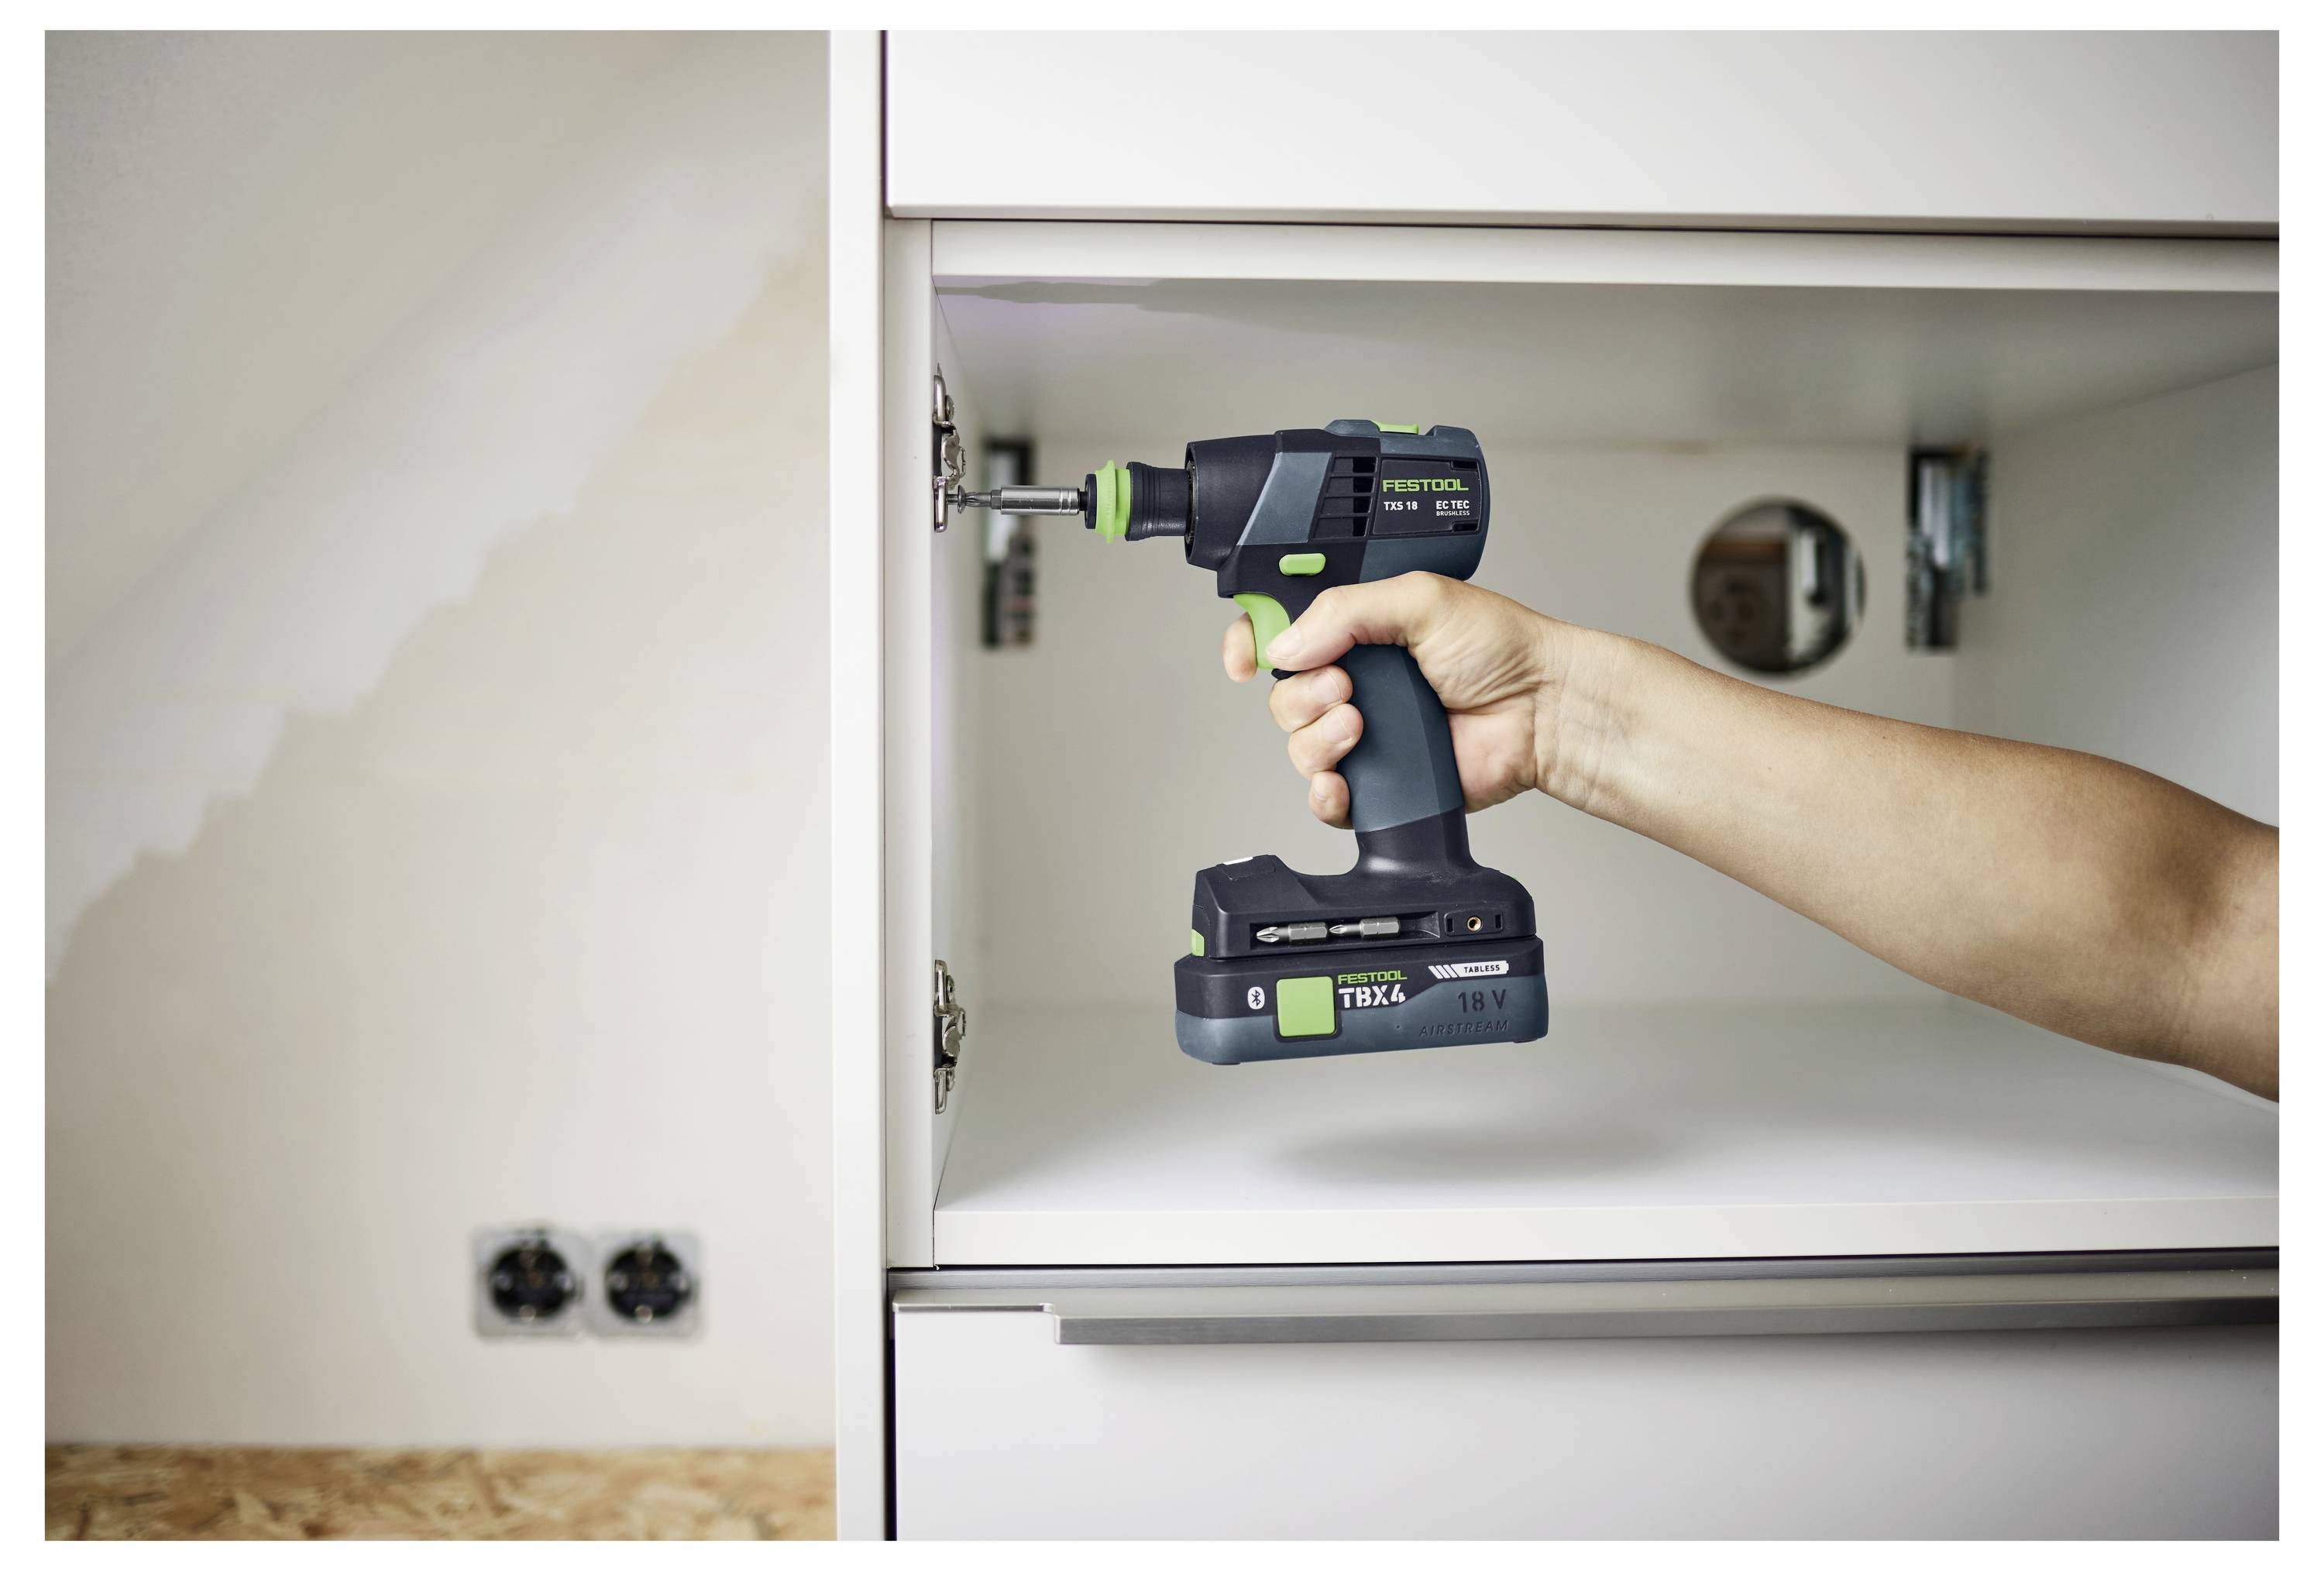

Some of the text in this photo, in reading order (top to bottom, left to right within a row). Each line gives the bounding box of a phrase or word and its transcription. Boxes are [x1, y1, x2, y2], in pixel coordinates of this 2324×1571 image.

[1382, 479, 1469, 492] FESTOOL
[1384, 501, 1418, 510] TXS 18
[1450, 500, 1470, 509] TEC
[1463, 964, 1500, 973] TABLESS
[1338, 971, 1408, 985] FESTOOL
[1338, 984, 1406, 1008] TBX4
[1458, 988, 1507, 1012] 18 V
[1419, 1020, 1509, 1037] AIRSTREAM
